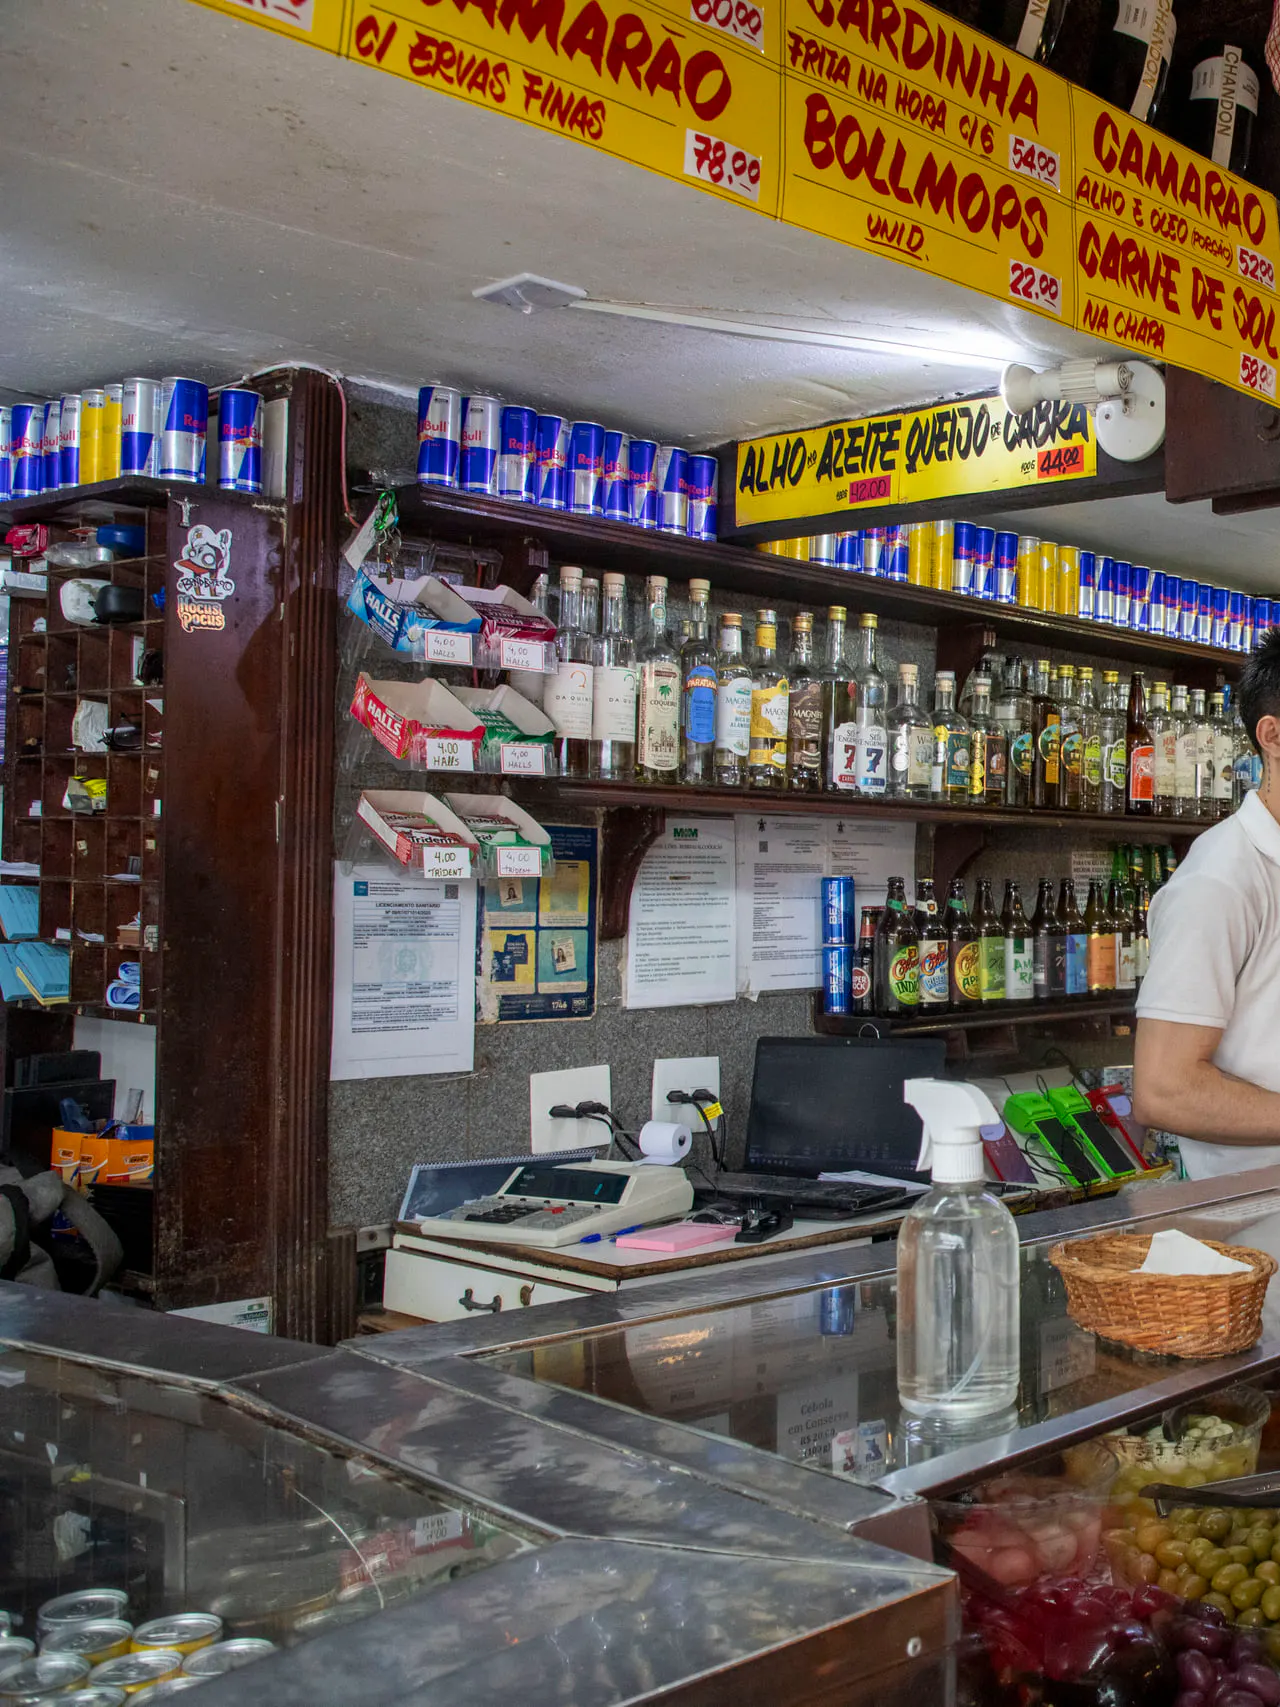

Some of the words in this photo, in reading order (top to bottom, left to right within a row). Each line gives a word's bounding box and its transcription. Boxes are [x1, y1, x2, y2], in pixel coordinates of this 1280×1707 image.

[409, 30, 510, 103] ERVAS
[523, 69, 606, 140] FINAS
[420, 0, 731, 121] MARÃO
[787, 30, 850, 89] FRITA
[858, 64, 887, 108] NA
[895, 81, 947, 134] HORA
[1217, 51, 1240, 137] CHANDON
[804, 92, 1048, 258] BOLLMOPS
[1077, 175, 1125, 216] ALHO
[1133, 198, 1144, 227] E
[1079, 221, 1180, 314] CARNE
[1192, 267, 1225, 331] DE
[1233, 287, 1279, 360] SOL
[1083, 300, 1108, 335] NA
[1114, 312, 1165, 352] CHAPA
[223, 424, 247, 437] Red
[424, 420, 447, 433] Bull
[739, 437, 806, 493] ALHO
[816, 420, 902, 483] AZEITE
[906, 404, 990, 473] QUEIJO
[365, 591, 400, 627] HALLS
[367, 699, 402, 738] HALLS
[828, 883, 838, 925] BEATS
[829, 950, 839, 993] BEATS
